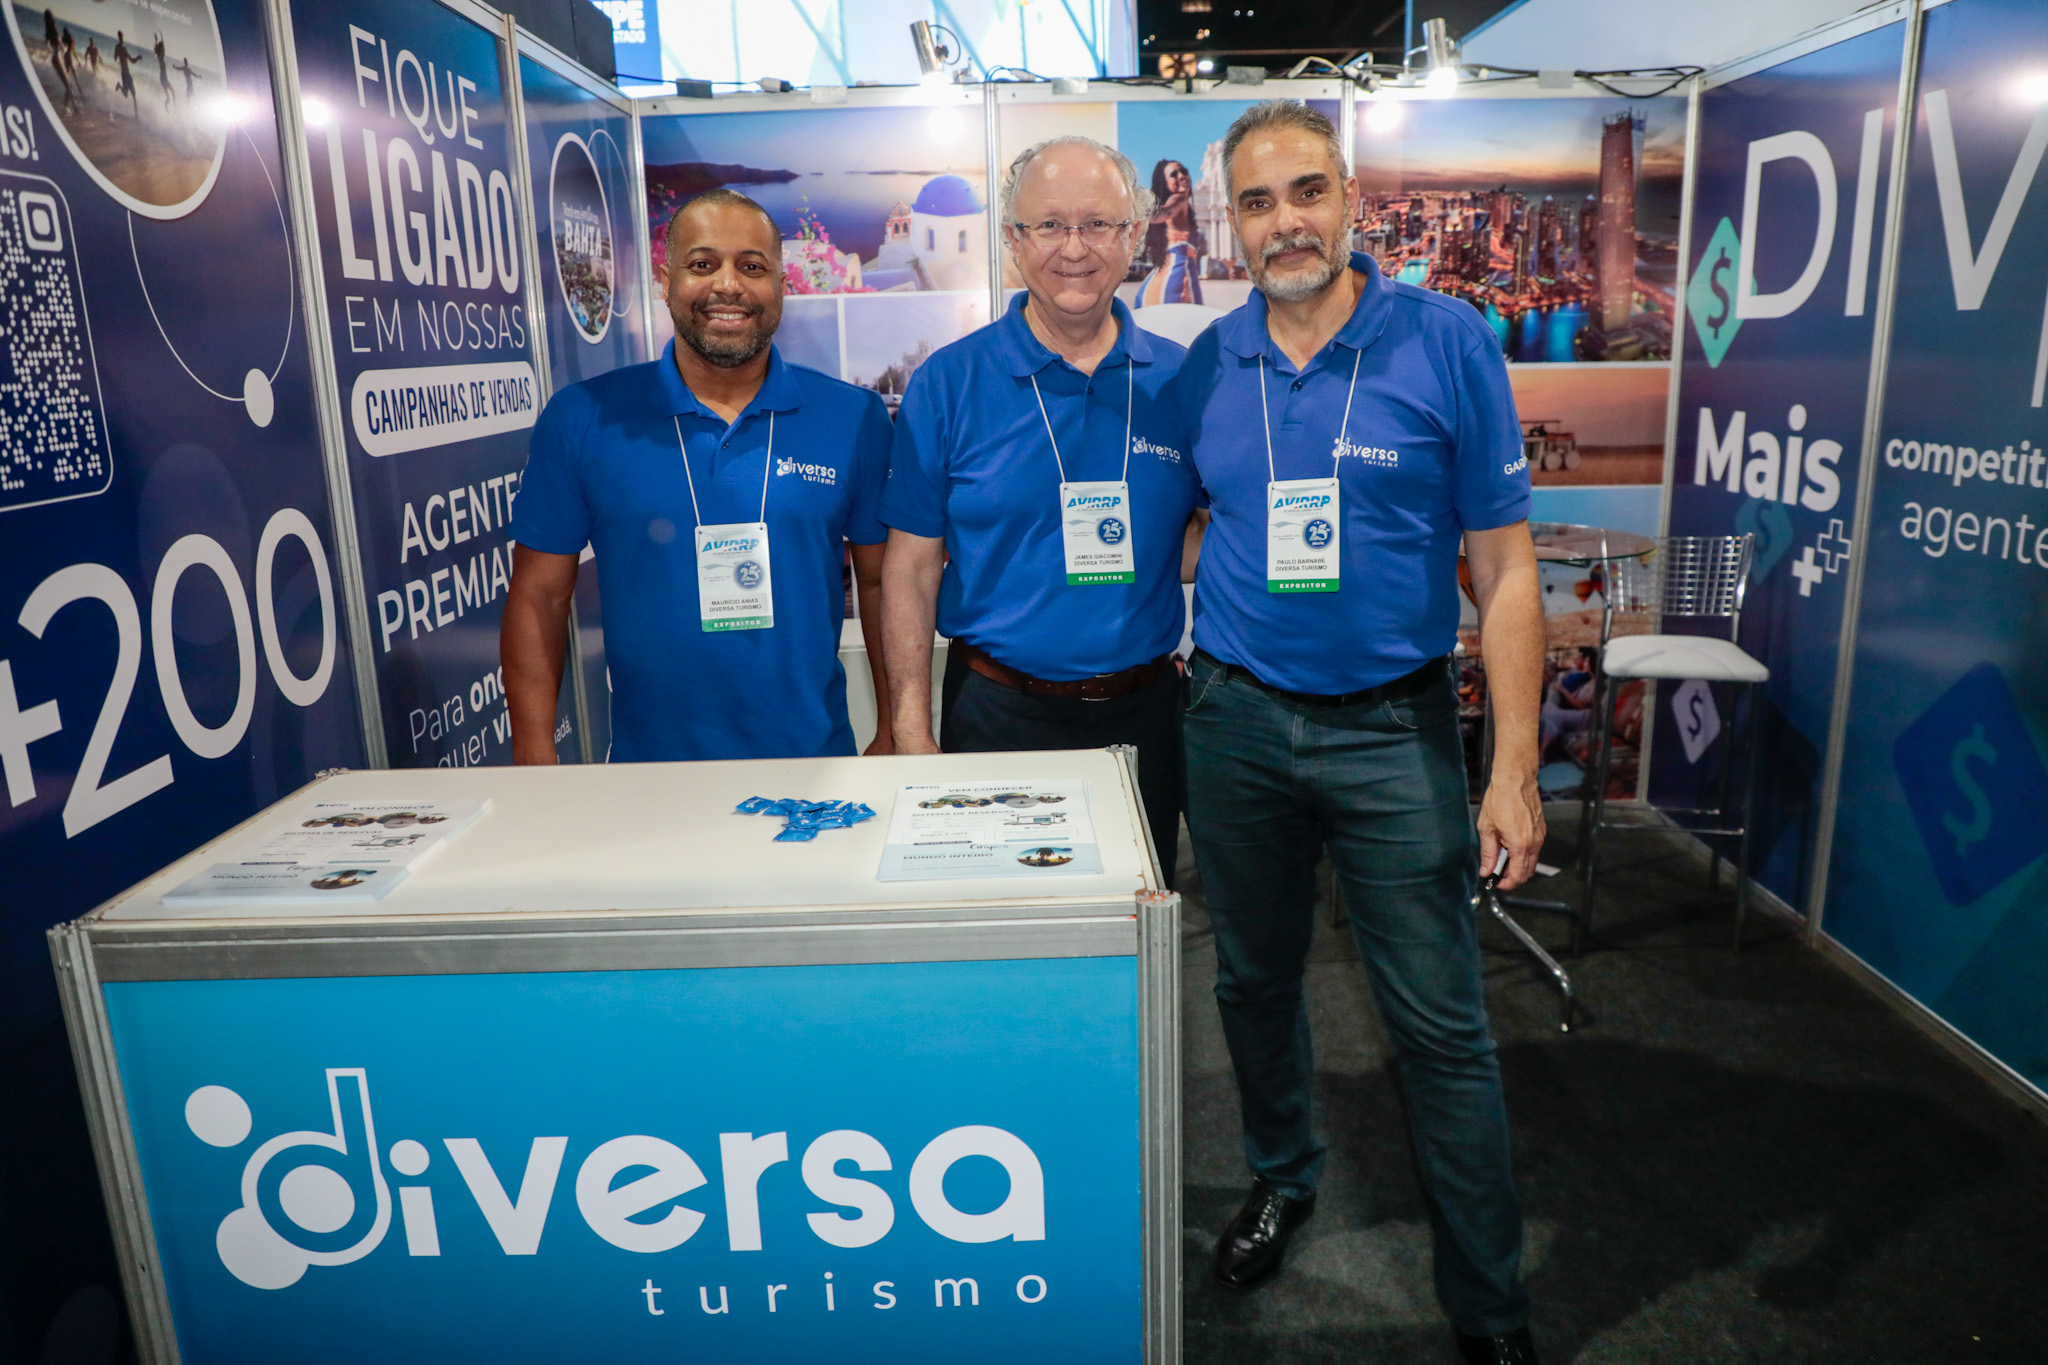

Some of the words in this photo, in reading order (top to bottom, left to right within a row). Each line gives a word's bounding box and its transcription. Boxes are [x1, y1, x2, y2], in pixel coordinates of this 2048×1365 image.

[349, 23, 484, 151] FIQUE
[325, 118, 520, 295] LIGADO
[564, 219, 602, 257] BAHIA
[345, 295, 404, 353] EM
[417, 300, 526, 351] NOSSAS
[365, 382, 468, 436] CAMPANHAS
[469, 380, 489, 419] DE
[488, 376, 532, 416] VENDAS
[1132, 436, 1181, 460] diversa
[1332, 437, 1399, 462] diversa
[1694, 404, 1843, 512] Mais
[1885, 438, 2048, 489] competit
[776, 457, 836, 479] diversa
[802, 473, 836, 486] turismo
[401, 469, 525, 565] AGENTE
[1066, 496, 1122, 509] AVIRRP
[1273, 495, 1331, 509] AVIRRP
[702, 538, 760, 554] AVIRRP
[1102, 522, 1119, 538] 25
[1308, 523, 1328, 541] 25
[740, 564, 759, 582] 25
[376, 540, 515, 653] PREMIA
[709, 605, 735, 613] DIVERSA
[714, 620, 761, 628] EXPOSITOR
[409, 694, 465, 754] Para
[492, 698, 513, 745] vi
[554, 715, 573, 745] adá,
[185, 1067, 1046, 1290] diversa
[641, 1271, 1048, 1317] turismo
